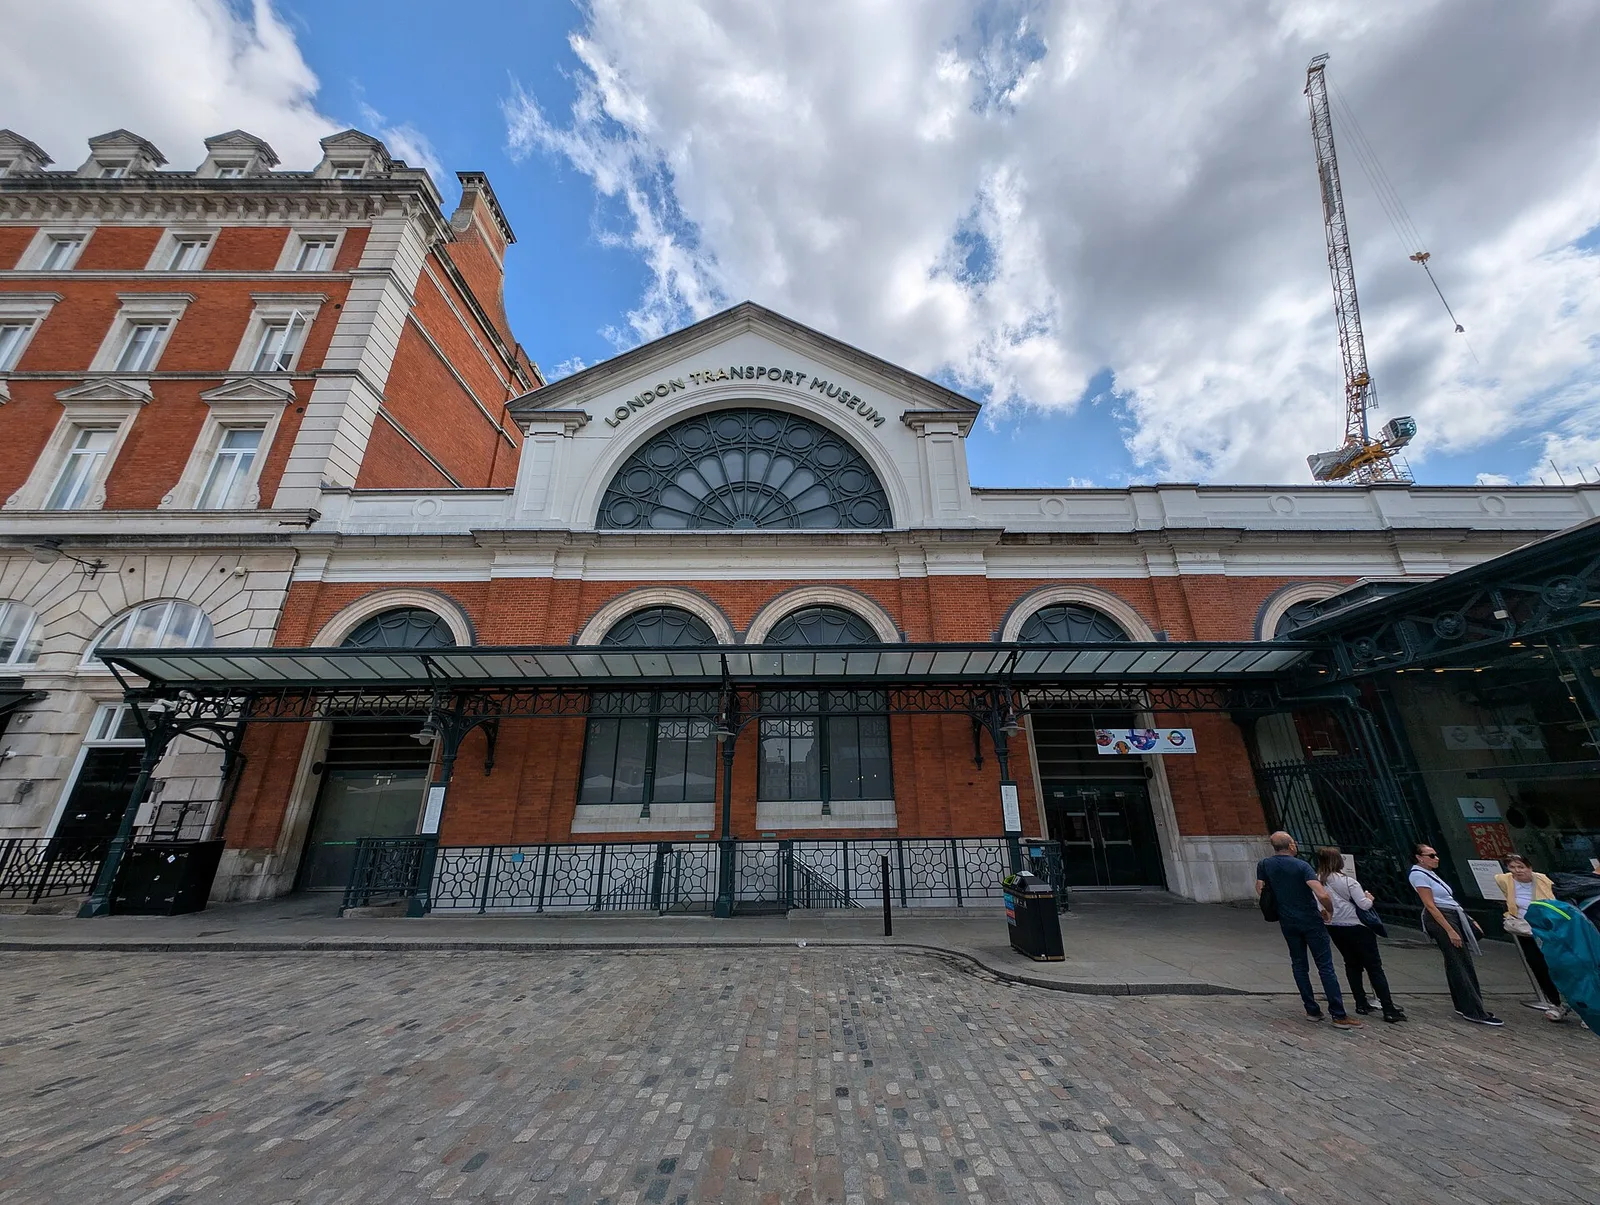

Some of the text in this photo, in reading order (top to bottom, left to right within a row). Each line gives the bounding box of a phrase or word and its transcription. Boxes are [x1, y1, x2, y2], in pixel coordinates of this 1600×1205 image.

[604, 365, 886, 428] LONDON TRANSPORT MUSEUM
